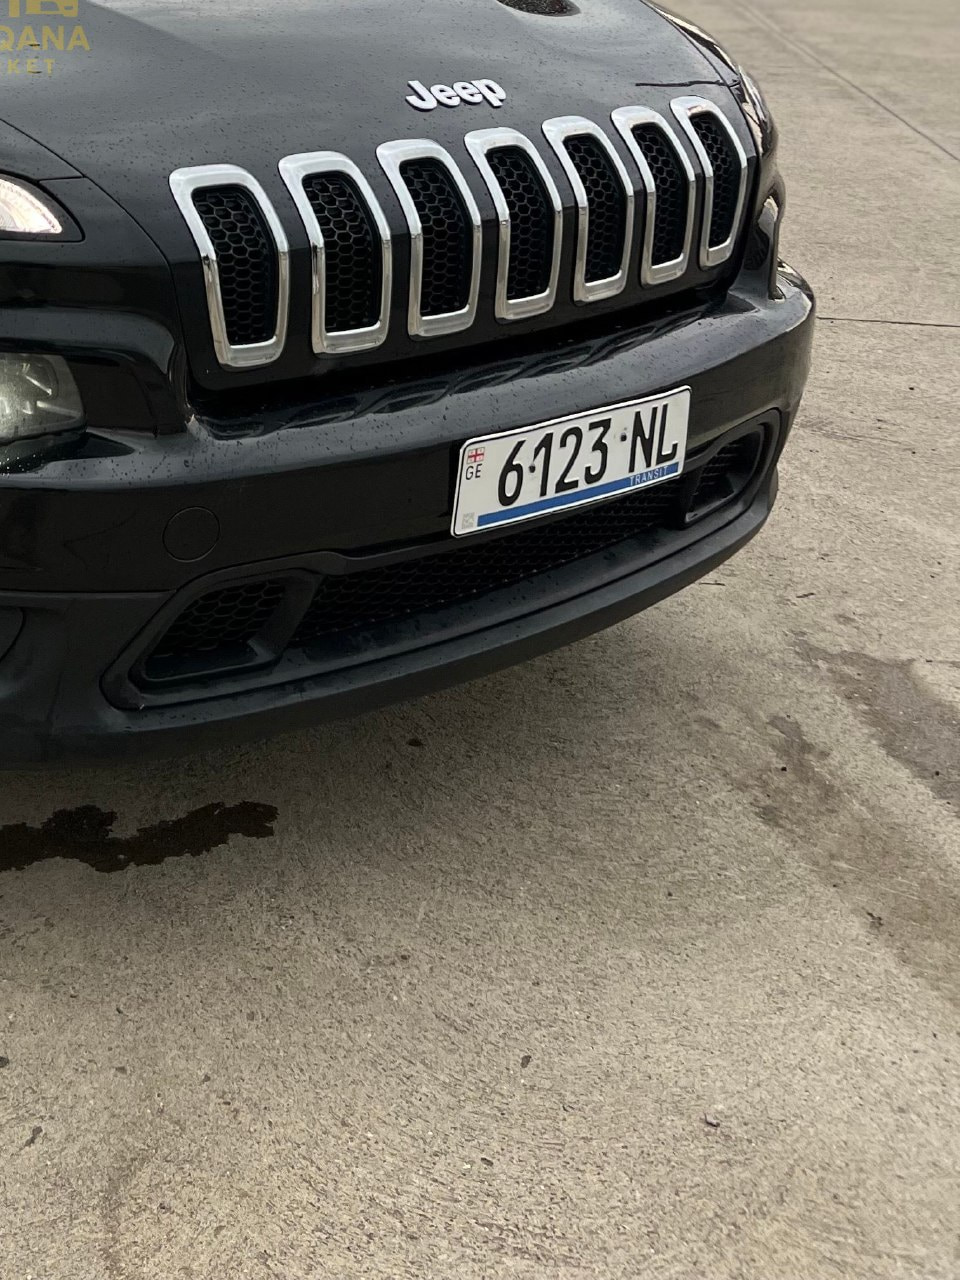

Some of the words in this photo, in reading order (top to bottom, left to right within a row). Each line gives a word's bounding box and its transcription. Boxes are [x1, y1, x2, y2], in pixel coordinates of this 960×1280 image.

[405, 78, 507, 111] Jeep
[497, 417, 612, 507] 6123
[628, 403, 679, 474] NL
[465, 463, 483, 481] GE
[629, 465, 669, 487] TRANSIT
